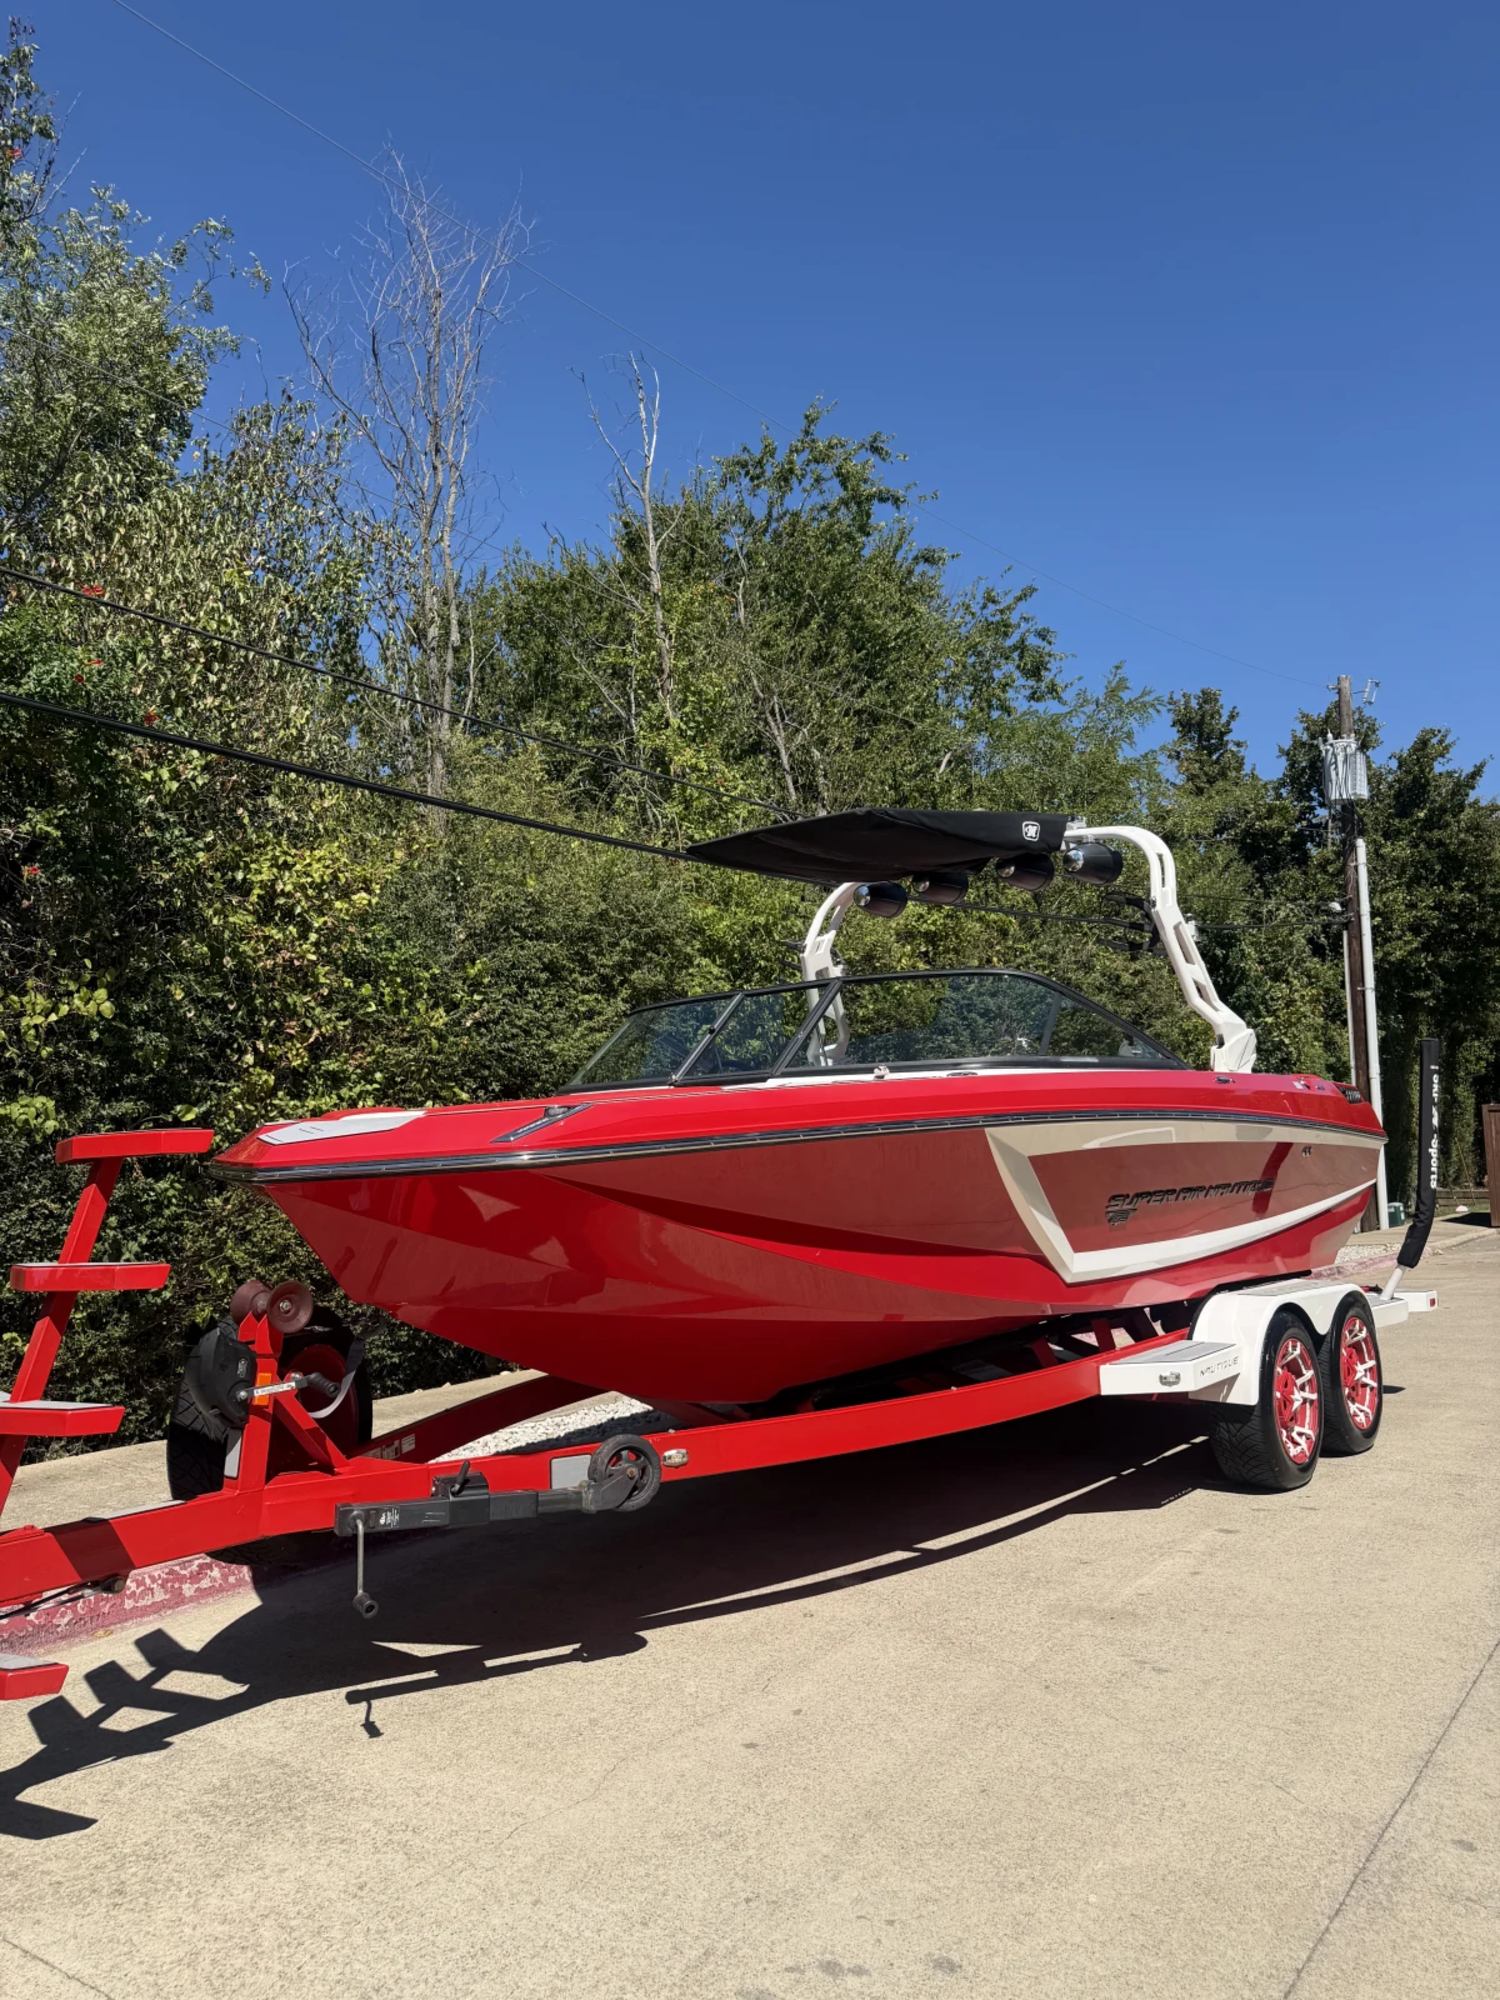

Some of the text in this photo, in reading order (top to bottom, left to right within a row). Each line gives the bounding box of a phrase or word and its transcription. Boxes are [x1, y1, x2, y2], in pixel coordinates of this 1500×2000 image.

[1105, 1188, 1177, 1210] SUPER
[1175, 1185, 1207, 1201] AIR
[1200, 1356, 1239, 1377] NAUTIQUE
